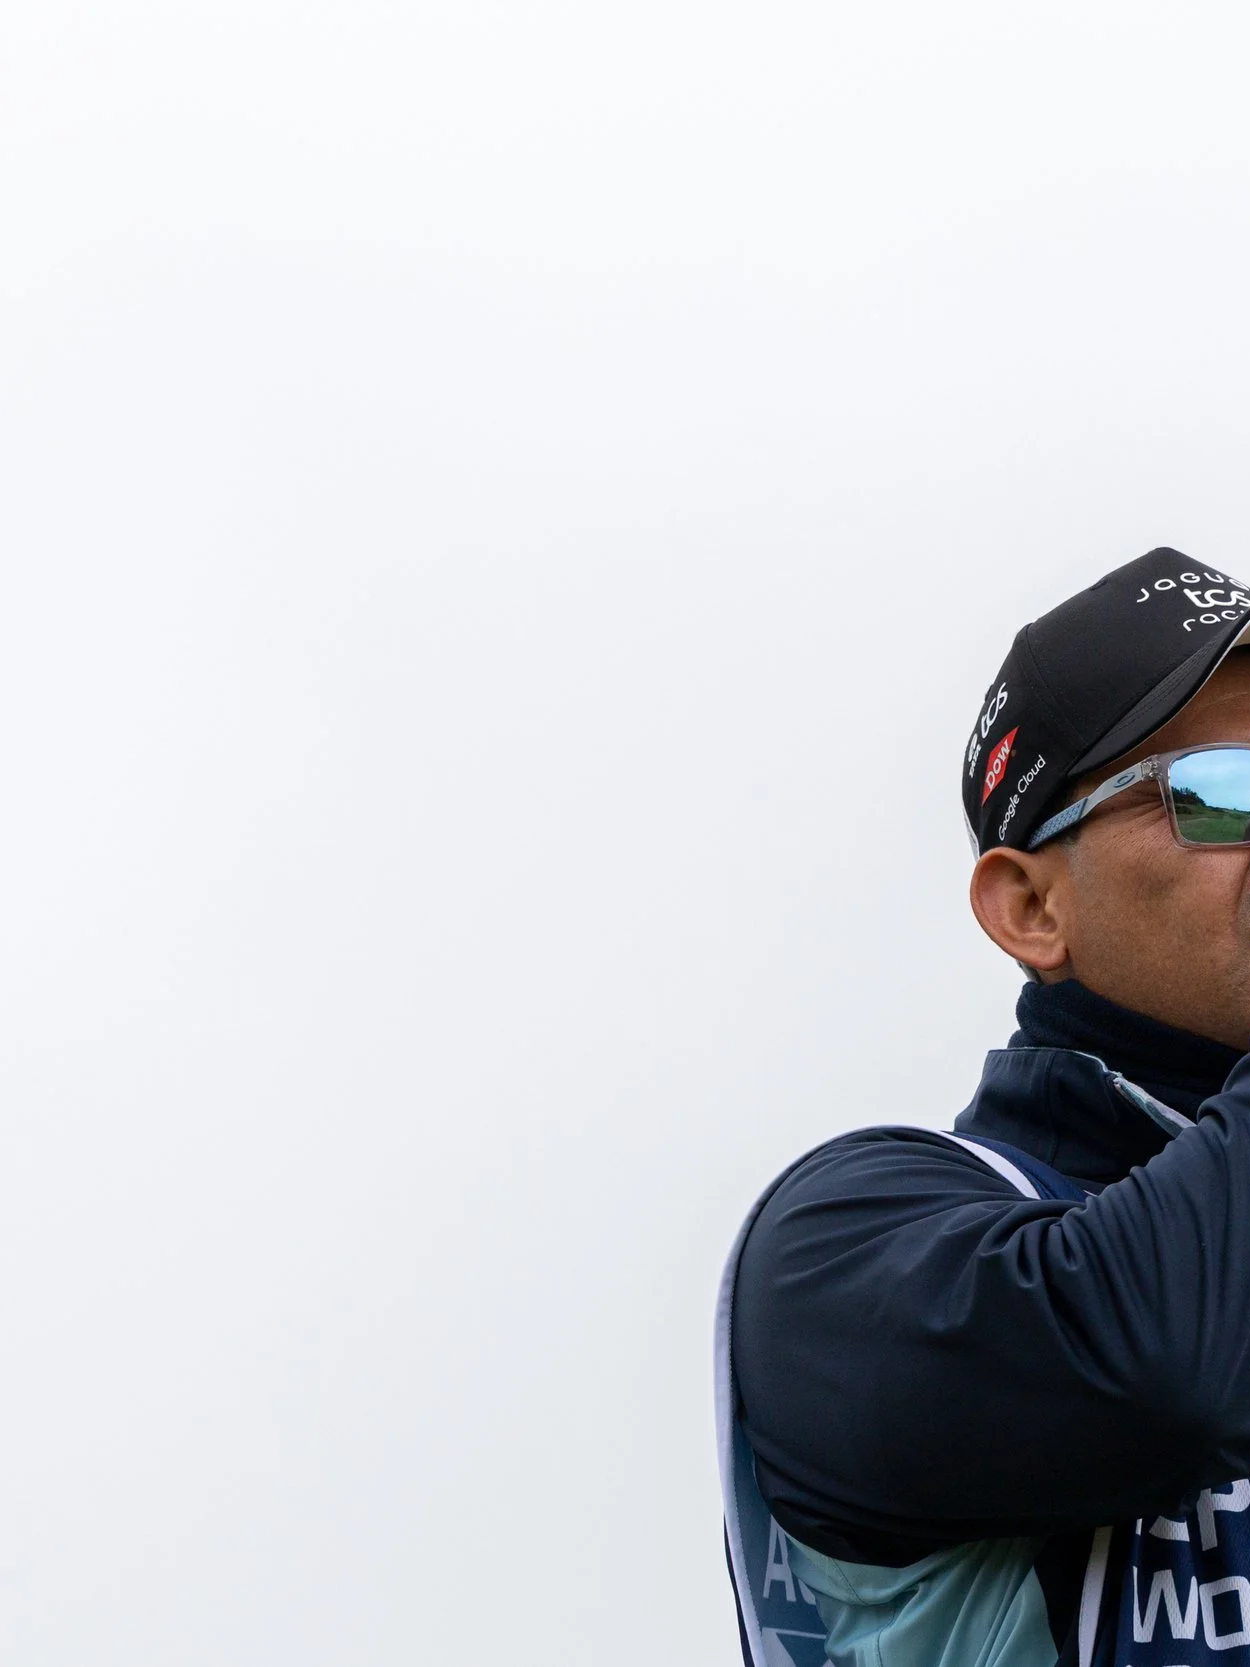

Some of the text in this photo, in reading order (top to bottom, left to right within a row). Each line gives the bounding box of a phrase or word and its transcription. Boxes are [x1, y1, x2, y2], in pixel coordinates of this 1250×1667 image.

[1183, 610, 1245, 632] rac
[980, 682, 1008, 739] tcs
[998, 754, 1047, 841] Google Cloud
